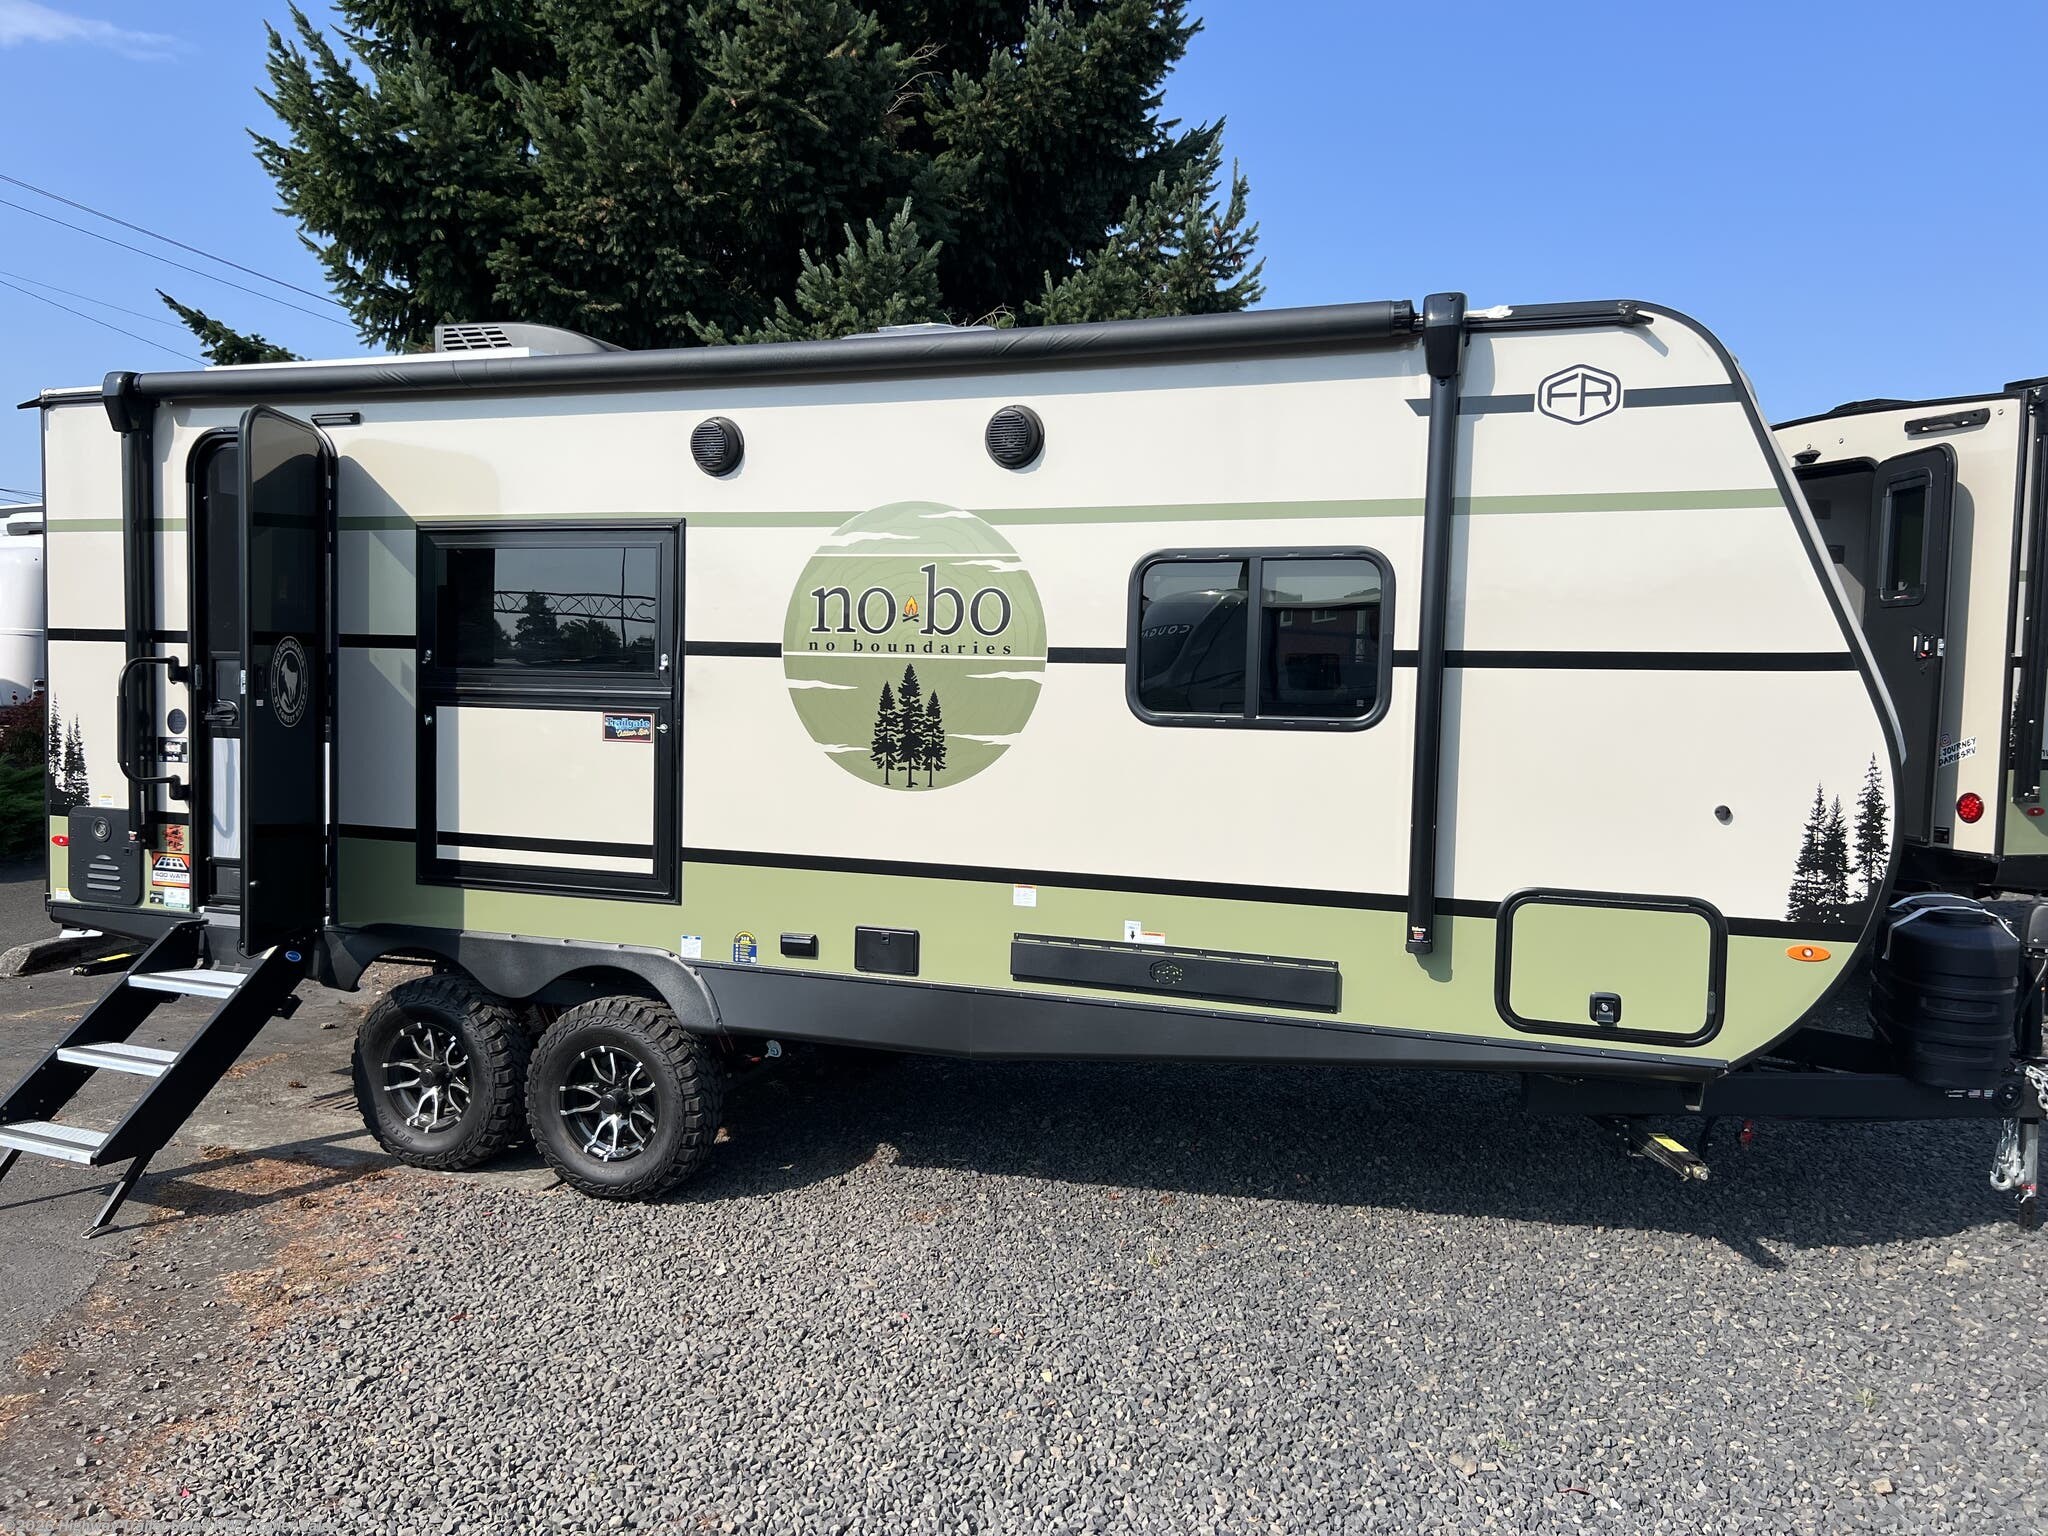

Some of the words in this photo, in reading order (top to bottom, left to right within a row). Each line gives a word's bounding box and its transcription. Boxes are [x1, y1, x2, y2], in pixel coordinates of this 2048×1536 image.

[808, 641, 836, 652] no
[853, 639, 1012, 655] boundaries
[1942, 736, 1977, 757] JOURNEY
